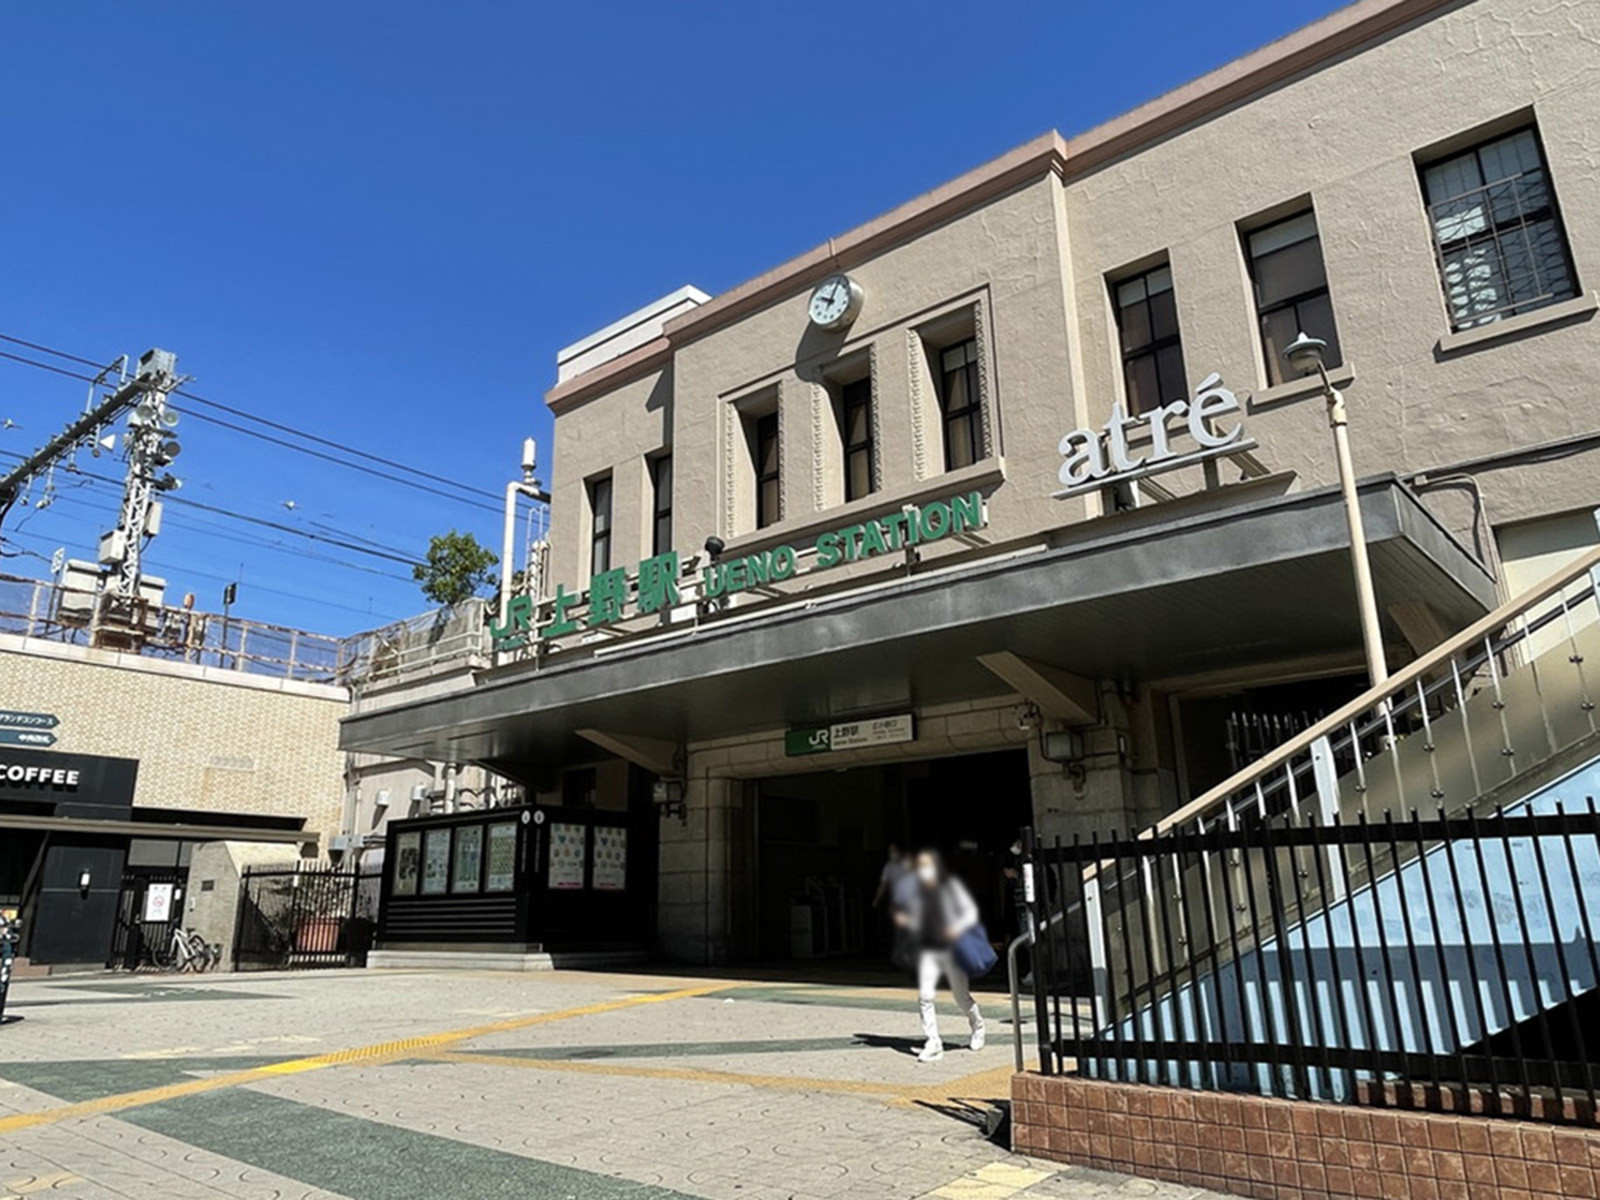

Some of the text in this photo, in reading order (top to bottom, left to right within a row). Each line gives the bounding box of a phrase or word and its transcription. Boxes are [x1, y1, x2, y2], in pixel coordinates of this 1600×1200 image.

[1058, 372, 1243, 486] atré
[704, 491, 983, 598] UENO STATION
[808, 729, 829, 746] JR
[0, 764, 80, 785] COFFEE
